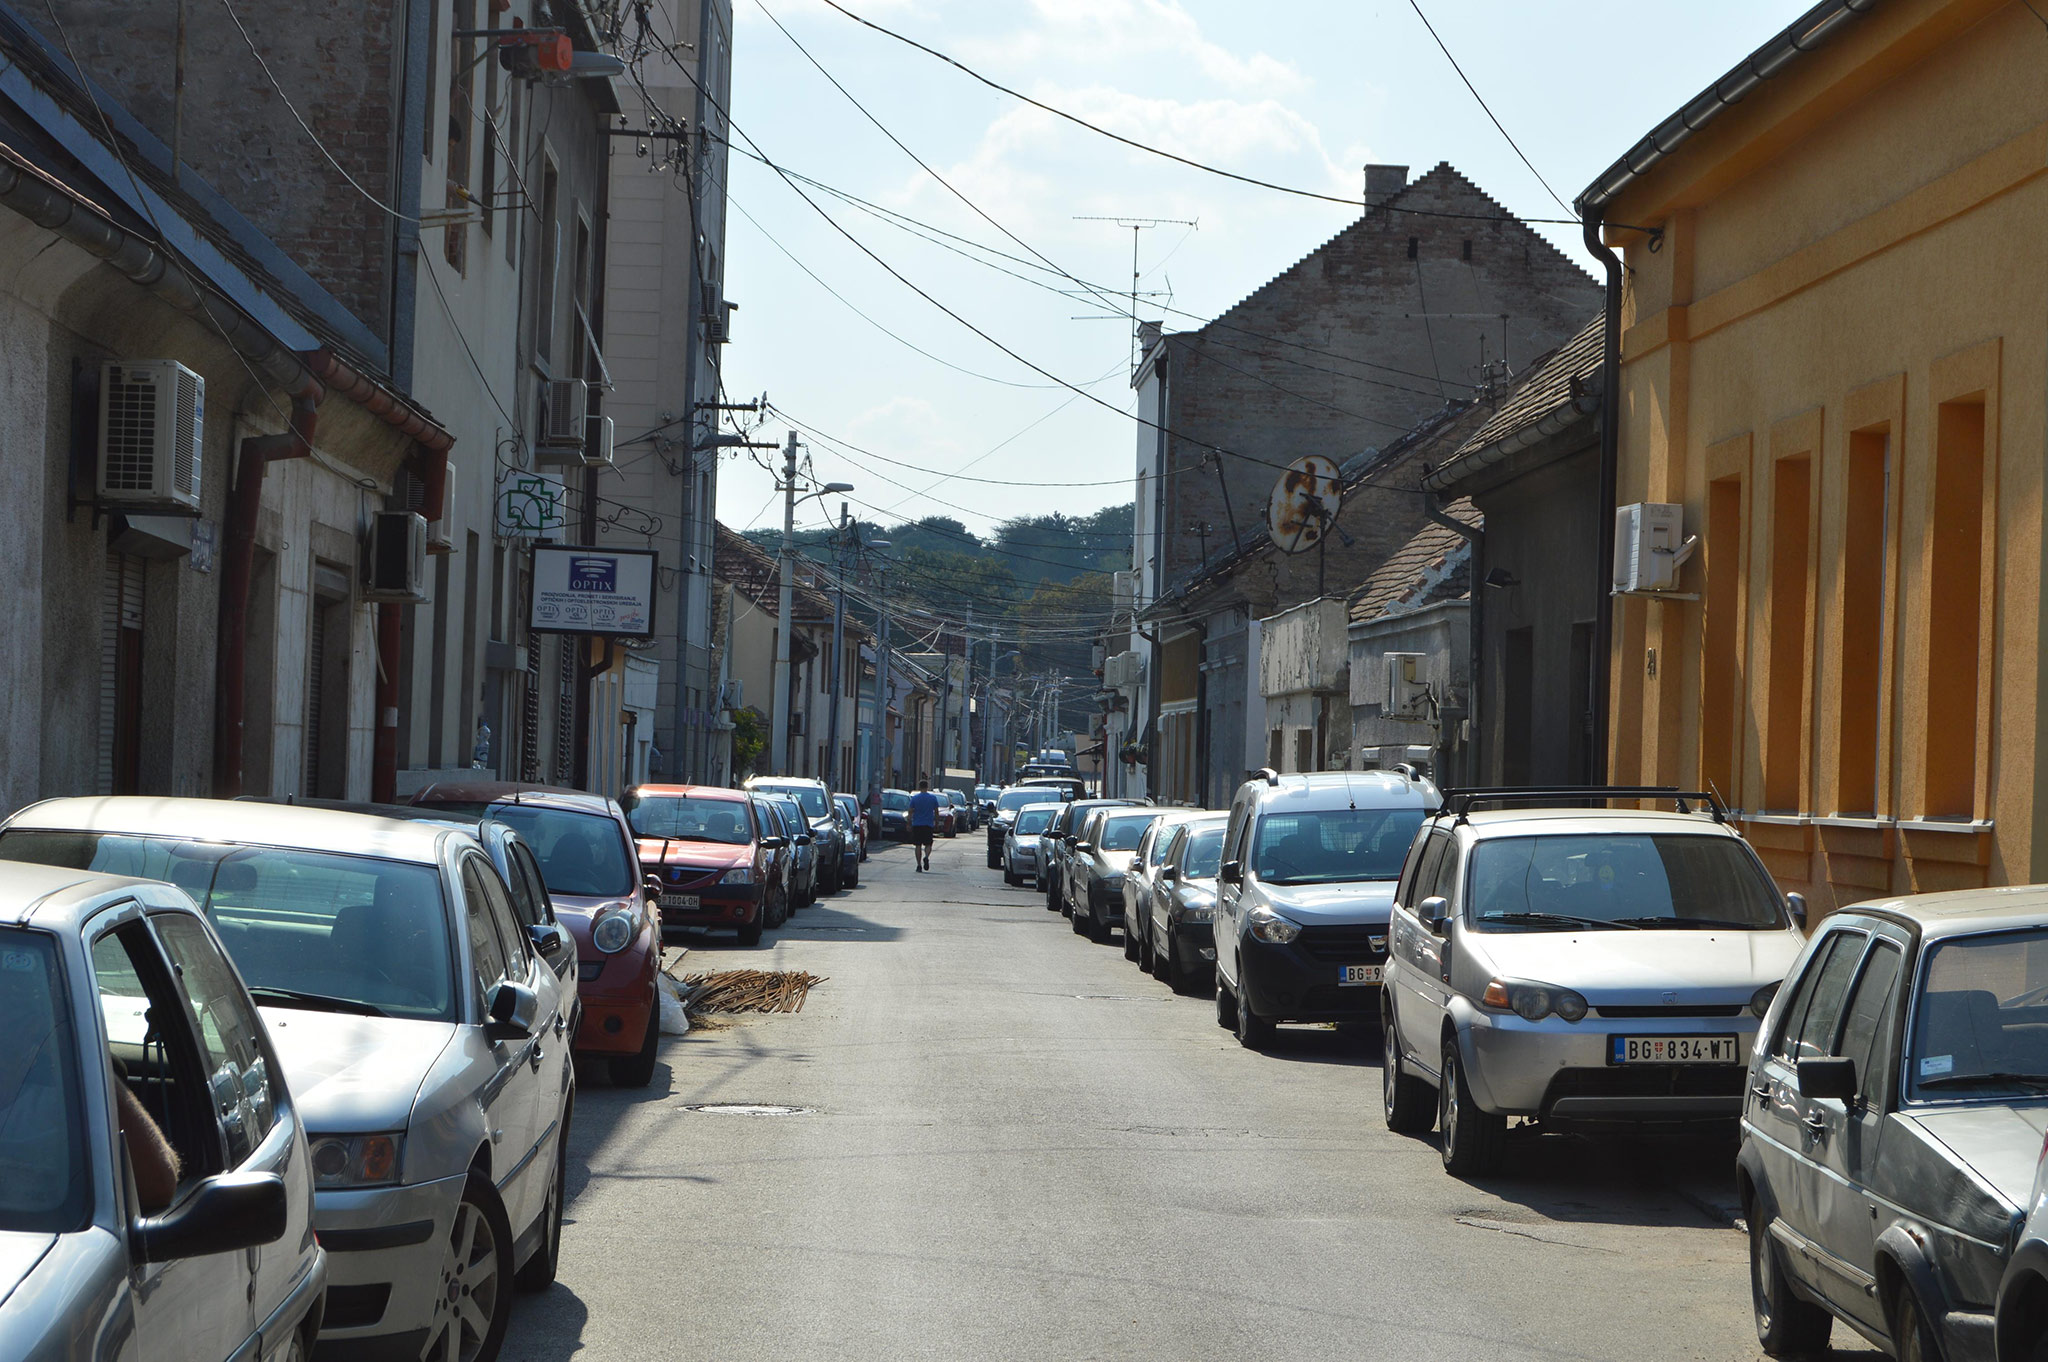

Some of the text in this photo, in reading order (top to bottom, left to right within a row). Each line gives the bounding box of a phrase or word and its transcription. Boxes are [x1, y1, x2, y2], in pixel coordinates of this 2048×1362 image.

[572, 579, 612, 591] OPTIX
[1349, 968, 1364, 980] BG
[1629, 1040, 1652, 1060] BG
